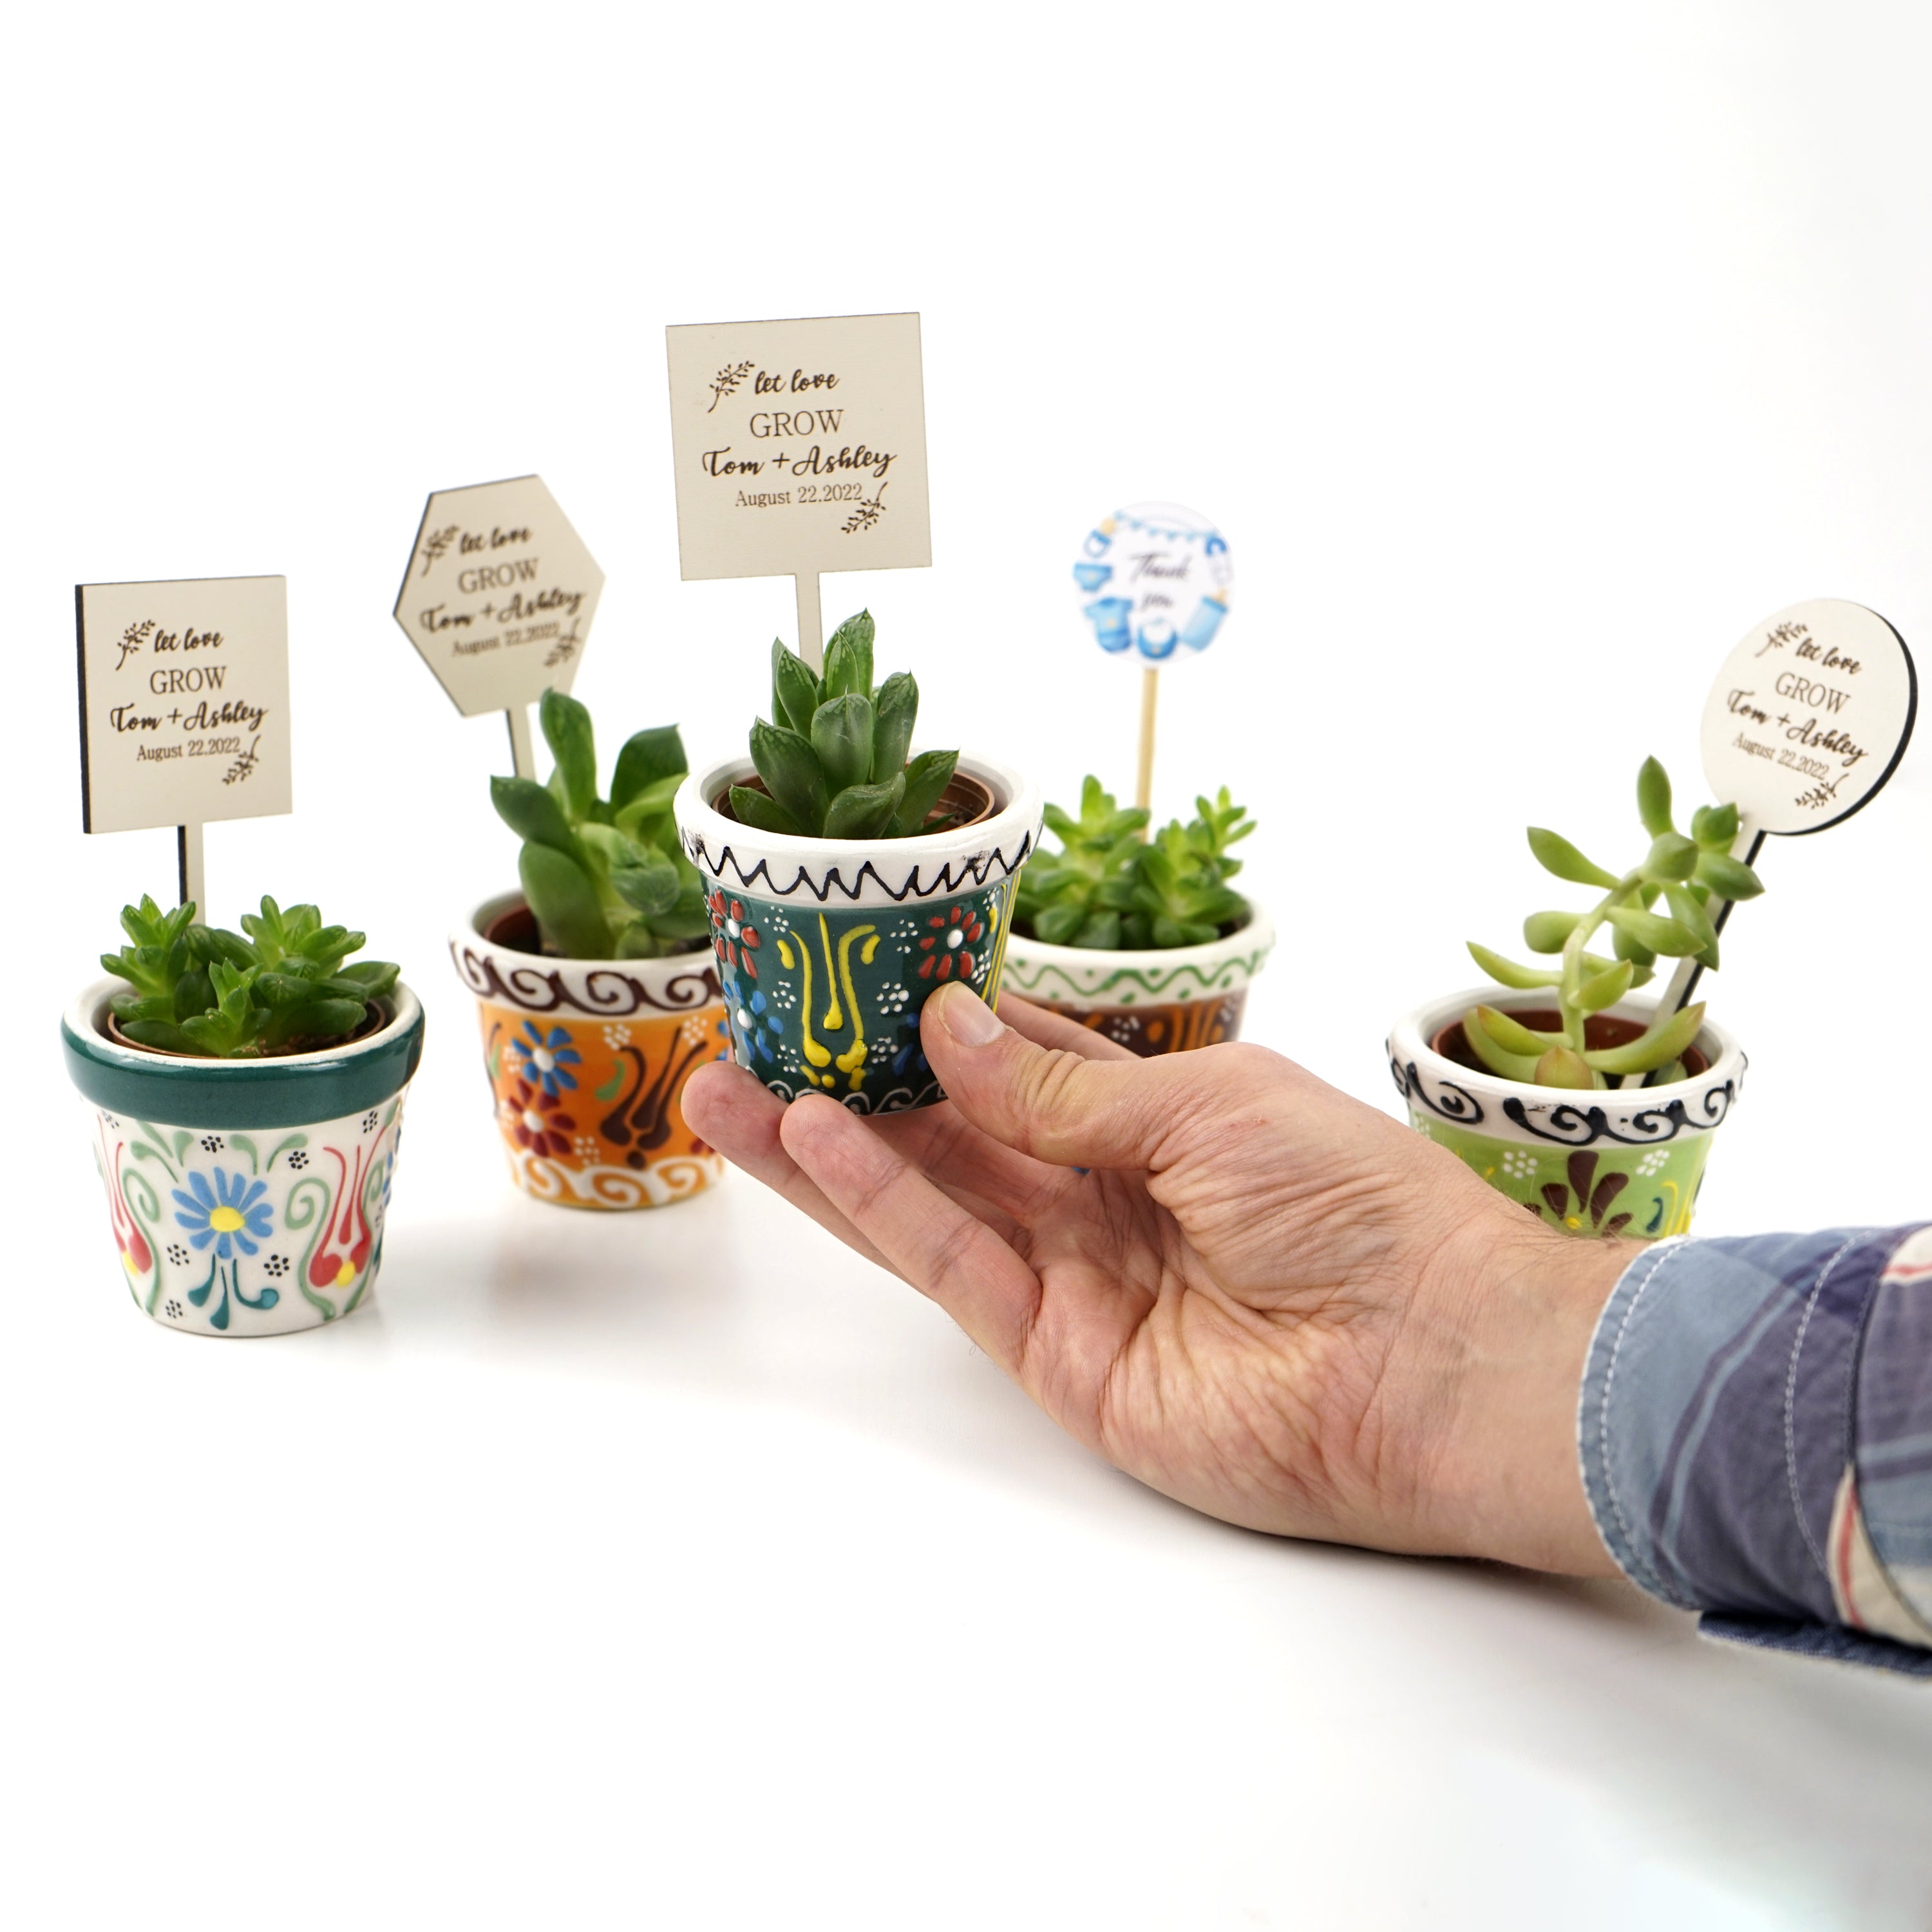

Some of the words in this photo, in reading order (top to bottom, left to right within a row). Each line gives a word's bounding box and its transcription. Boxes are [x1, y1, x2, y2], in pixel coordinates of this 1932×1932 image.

[755, 371, 786, 395] let
[791, 369, 840, 393] love
[750, 409, 844, 438] GROW
[703, 446, 764, 477] Tom
[792, 446, 897, 478] Ashley
[735, 491, 791, 508] August
[798, 483, 862, 504] 22.2022
[460, 533, 486, 554] let
[491, 526, 533, 549] love
[457, 557, 539, 594] GROW
[419, 602, 475, 633] Tom
[497, 586, 585, 621] Ashley
[155, 629, 181, 652] let
[184, 627, 223, 650] love
[452, 637, 502, 658] August
[1795, 638, 1822, 661] let
[1822, 647, 1862, 675] love
[150, 666, 227, 694] GROW
[1775, 672, 1852, 714] GROW
[110, 703, 162, 732] Tom
[183, 701, 269, 732] Ashley
[1727, 688, 1771, 724] Tom
[1786, 718, 1868, 767] Ashley
[137, 744, 182, 762] August
[188, 737, 241, 757] 22.2022
[1732, 732, 1776, 761] August
[1777, 748, 1830, 781] 22.2022
